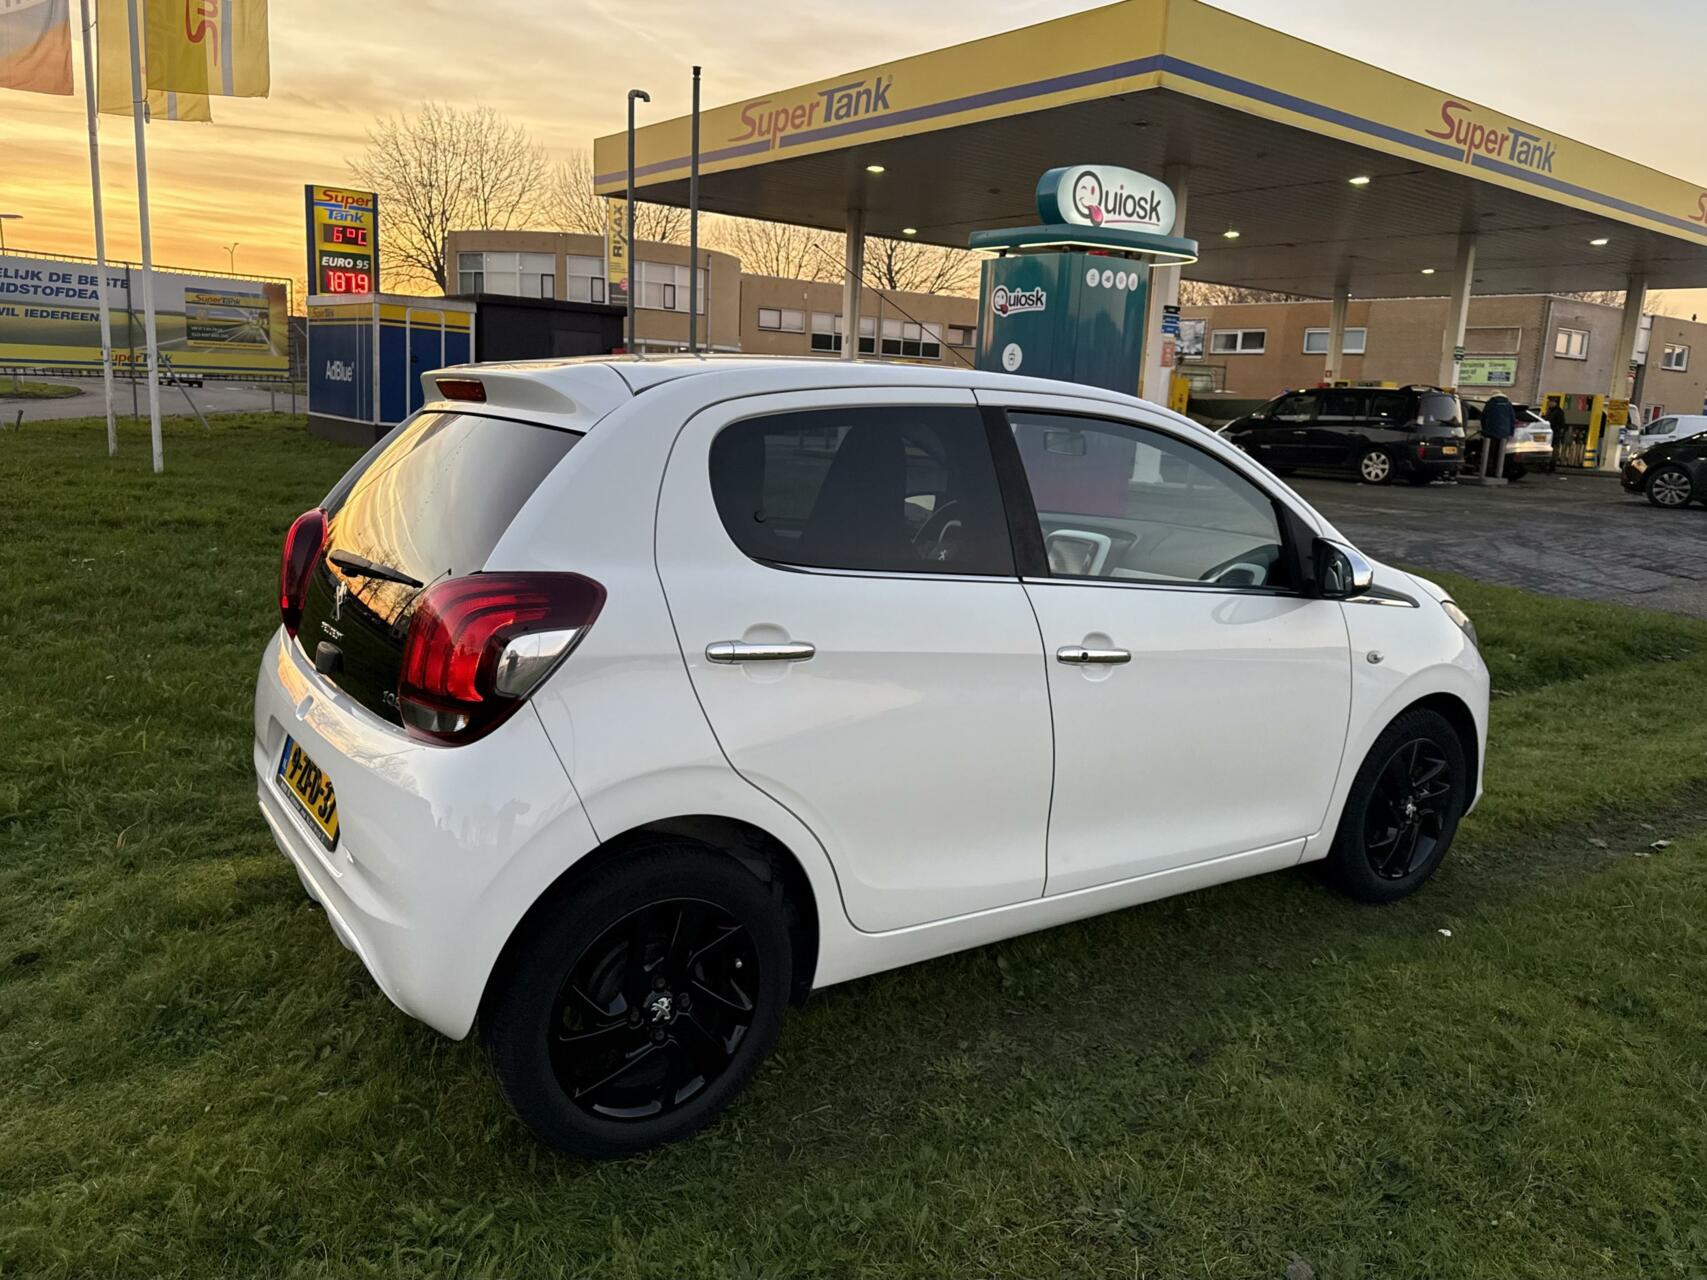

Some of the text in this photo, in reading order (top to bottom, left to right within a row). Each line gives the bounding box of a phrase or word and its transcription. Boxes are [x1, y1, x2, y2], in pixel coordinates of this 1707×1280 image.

[1425, 100, 1556, 173] SuperTank
[321, 189, 372, 209] Super
[1073, 170, 1161, 227] Quiosk
[324, 208, 364, 223] Tank
[321, 256, 369, 270] EURO 95
[48, 272, 73, 284] DE
[993, 288, 1045, 314] Quiosk
[25, 309, 100, 322] IEDEREEN
